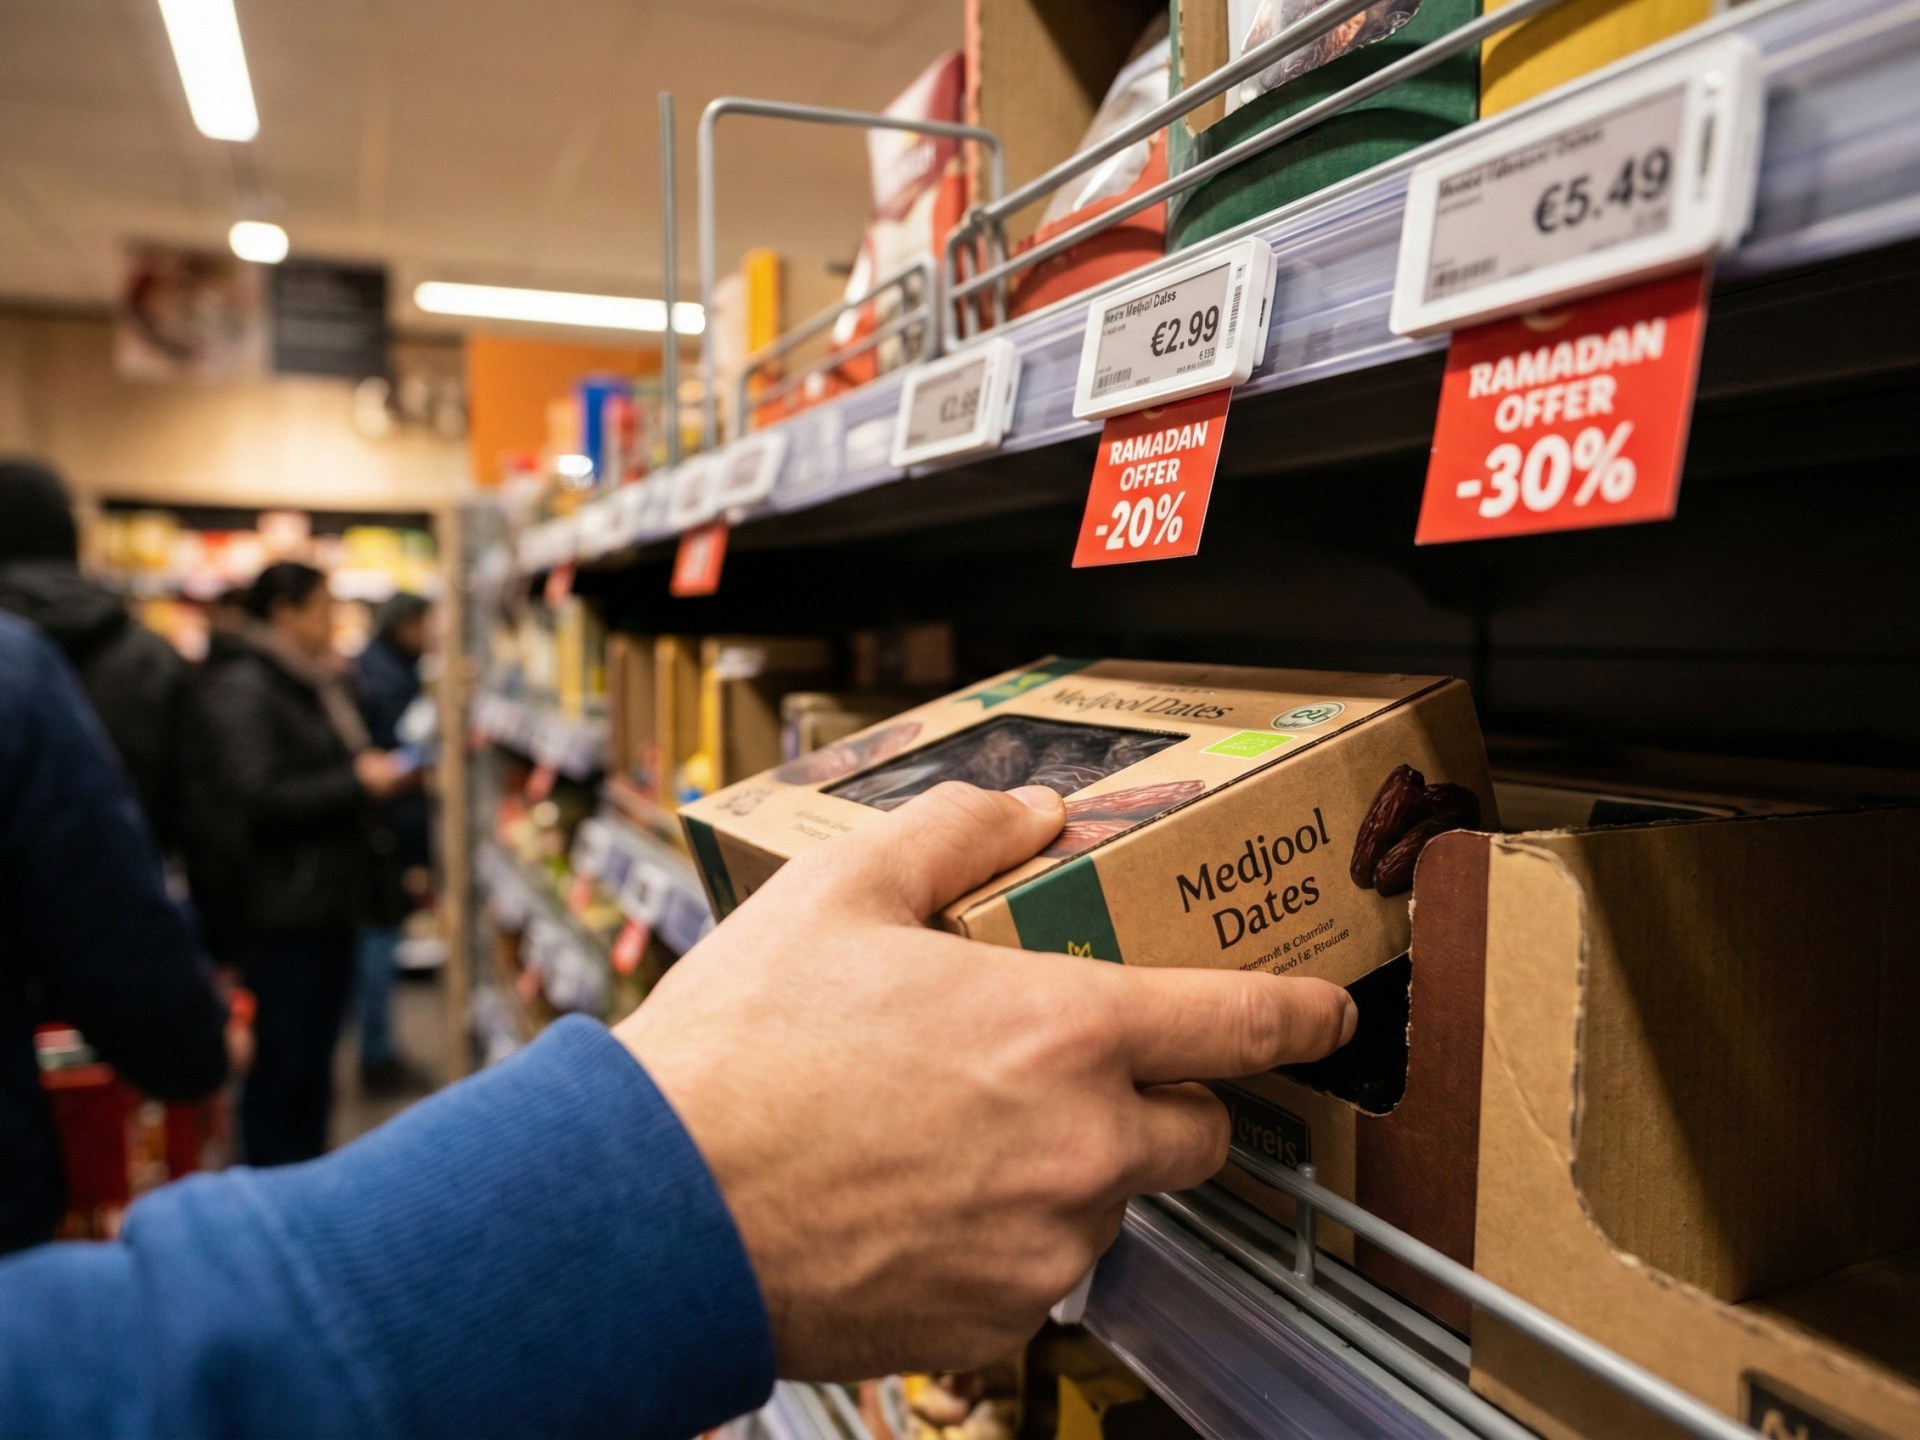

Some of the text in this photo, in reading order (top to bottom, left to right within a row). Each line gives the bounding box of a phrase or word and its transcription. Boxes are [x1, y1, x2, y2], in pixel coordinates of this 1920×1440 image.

[1533, 147, 1673, 235] €5.49
[1151, 305, 1219, 357] €2.99
[1468, 317, 1667, 399] RAMADAN
[1494, 374, 1617, 433] OFFER
[1109, 420, 1209, 466] RAMADAN
[1455, 420, 1637, 518] -30%
[1120, 458, 1180, 492] OFFER
[1095, 491, 1186, 550] -20%
[1144, 696, 1234, 719] Dates
[1176, 807, 1331, 913] Medjool
[1211, 876, 1320, 950] Dates
